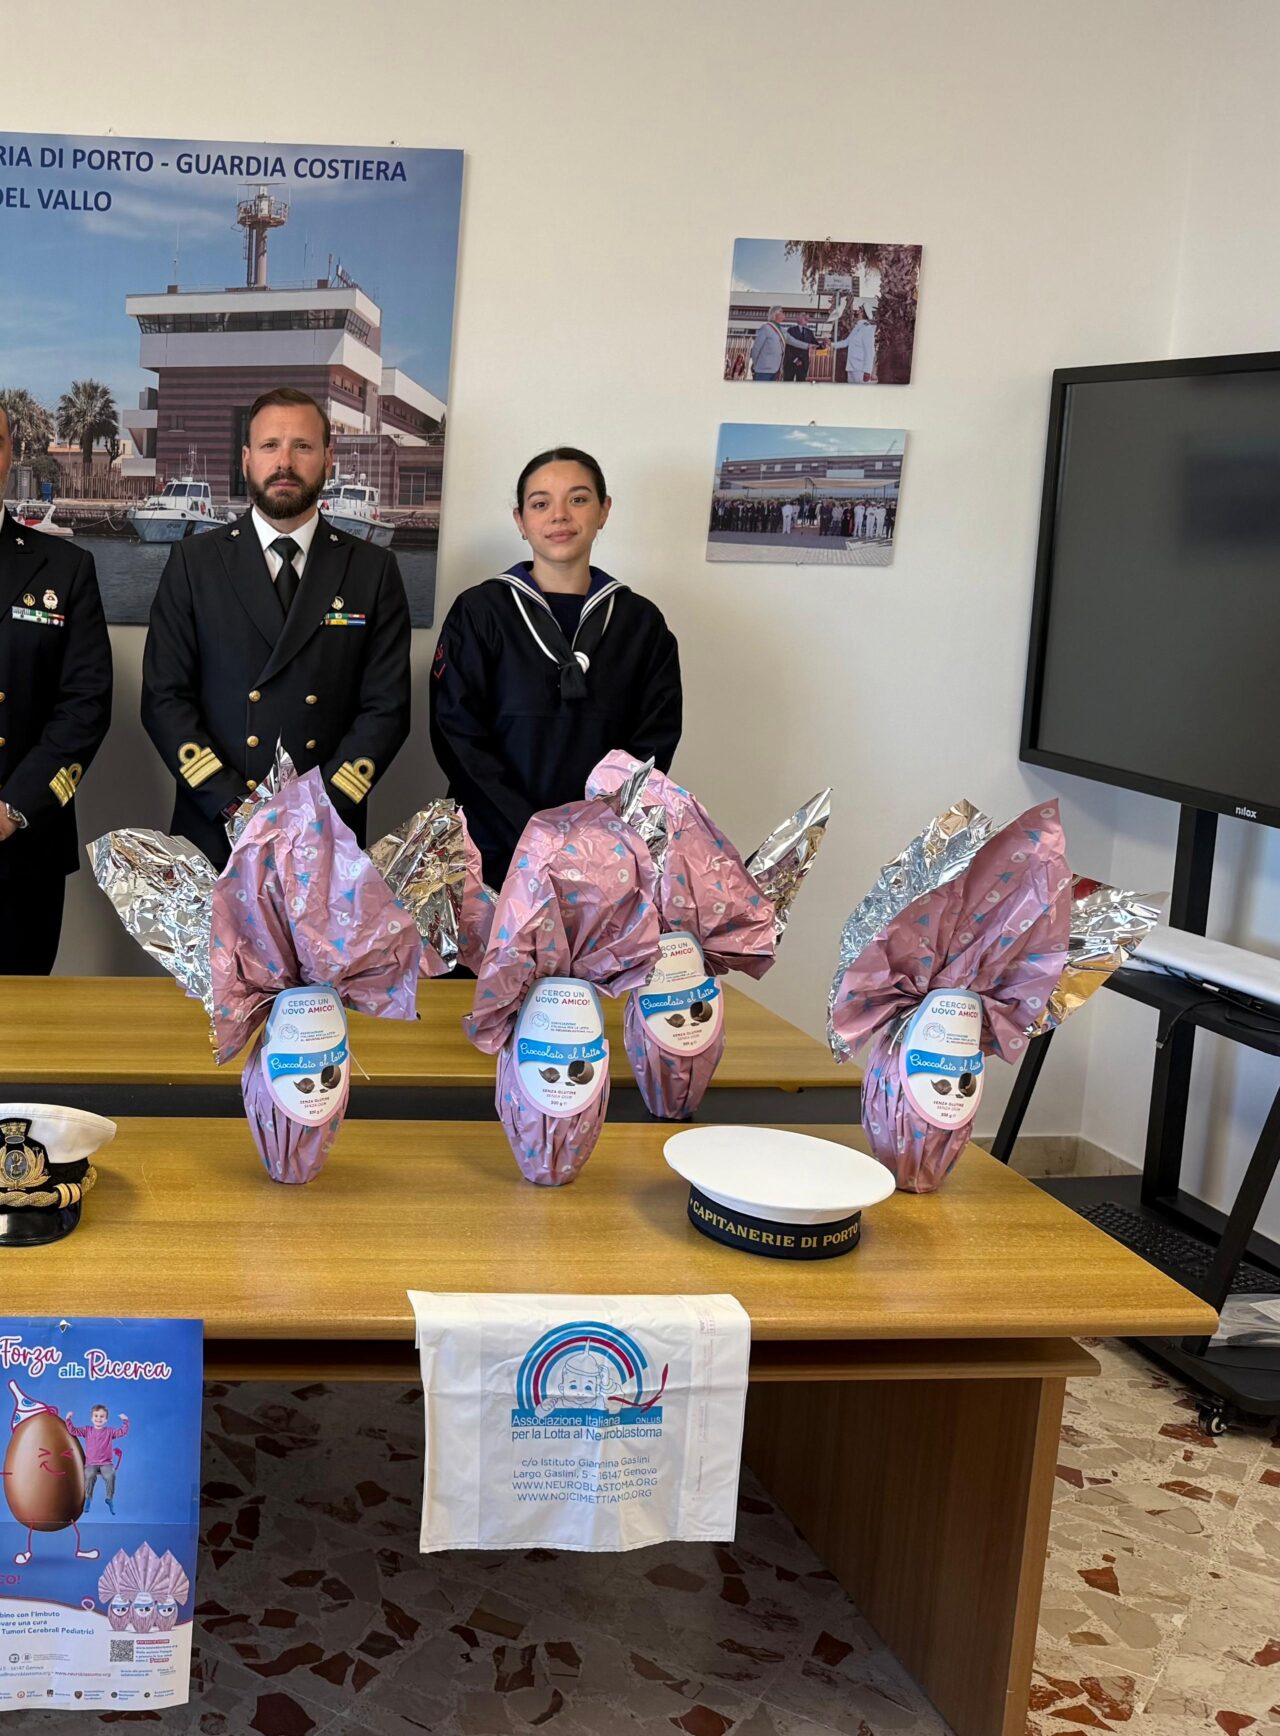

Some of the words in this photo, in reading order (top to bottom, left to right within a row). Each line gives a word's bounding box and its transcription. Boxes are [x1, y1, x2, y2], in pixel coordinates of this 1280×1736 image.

[40, 147, 63, 168] DI
[72, 148, 153, 171] PORTO
[176, 153, 286, 177] GUARDIA
[294, 158, 407, 182] COSTIERA
[37, 188, 112, 212] VALLO
[1236, 806, 1256, 818] nilox
[670, 947, 694, 957] AMICO!
[542, 989, 570, 997] CERCO
[642, 996, 684, 1009] Cioccolato
[687, 992, 697, 1003] al
[698, 986, 714, 999] latte
[561, 998, 591, 1006] AMICO!
[939, 1001, 966, 1009] CERCO
[307, 1005, 335, 1014] AMICO!
[932, 1008, 956, 1016] UOVO
[520, 1043, 564, 1059] Cioccolato
[568, 1048, 578, 1060] al
[582, 1046, 601, 1058] latte
[271, 1056, 316, 1070] Cioccolato
[319, 1054, 329, 1067] al
[331, 1051, 345, 1062] latte
[910, 1054, 956, 1071] Cioccolato
[960, 1060, 968, 1072] al
[693, 1201, 795, 1247] CAPITANERIE
[801, 1236, 818, 1248] DI
[822, 1224, 858, 1247] PORTO
[59, 1362, 85, 1378] alla
[85, 1349, 172, 1380] Ricerca
[512, 1415, 581, 1426] Associazione
[585, 1415, 620, 1427] Italiana
[635, 1416, 661, 1424] ONLUS
[512, 1430, 527, 1442] per
[532, 1428, 542, 1439] la
[544, 1428, 570, 1439] Lotta
[573, 1428, 583, 1439] al
[586, 1427, 662, 1441] Neuroblastoma
[522, 1458, 538, 1467] c/o
[541, 1458, 575, 1467] Istituto
[621, 1456, 650, 1466] Gaslini
[513, 1470, 542, 1480] Largo
[544, 1470, 579, 1479] Gaslini,
[582, 1471, 588, 1479] 5
[599, 1470, 622, 1480] 16147
[624, 1467, 657, 1477] Genova
[512, 1478, 658, 1493] WWW.NEUROBLASTOMA.ORG
